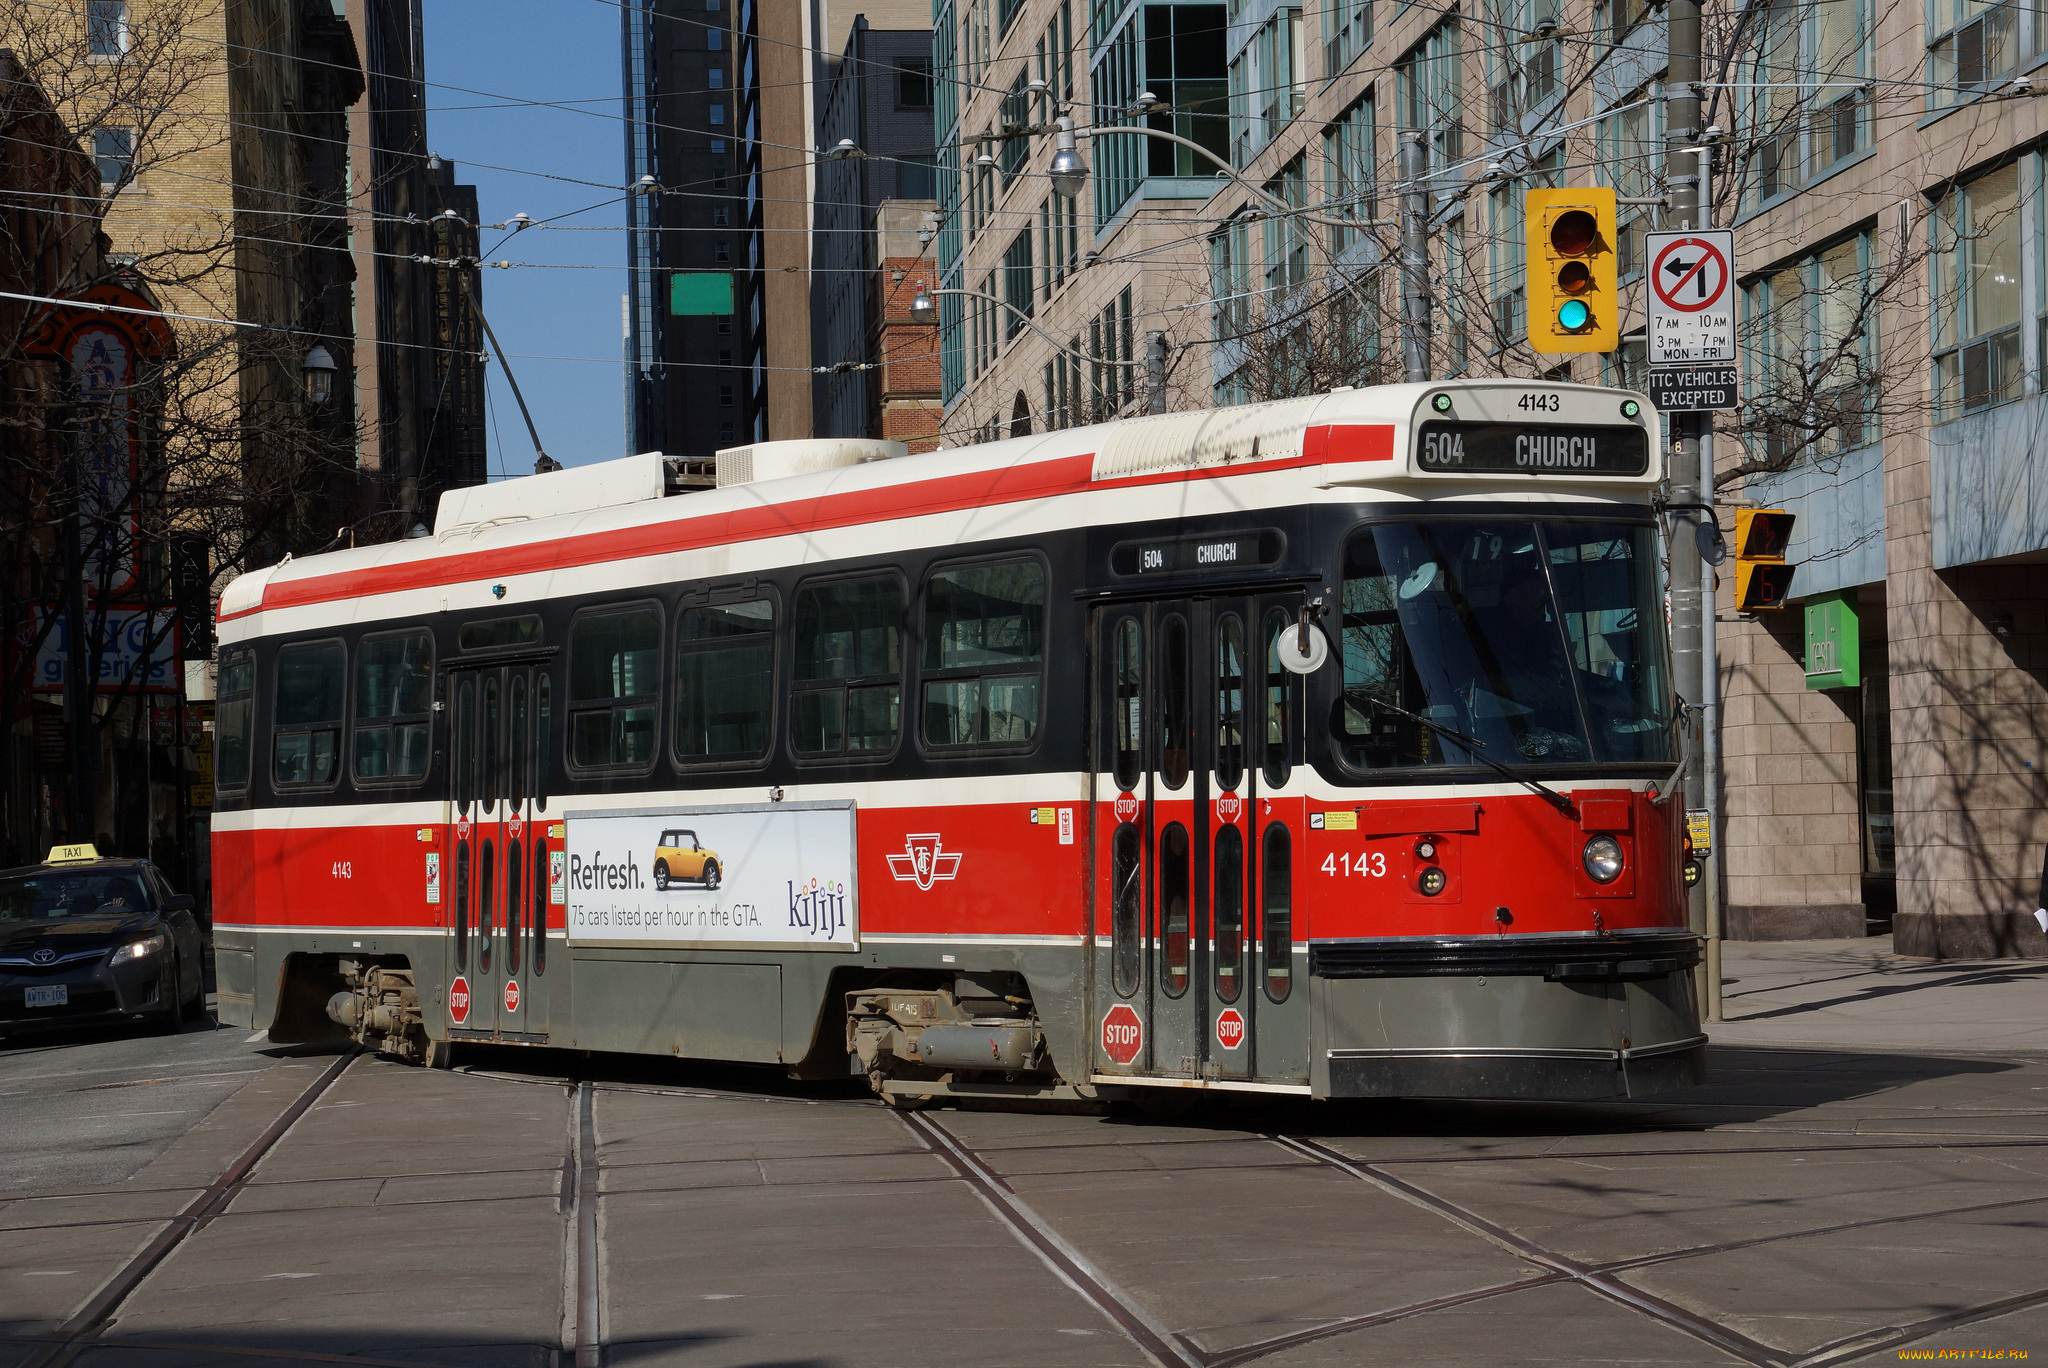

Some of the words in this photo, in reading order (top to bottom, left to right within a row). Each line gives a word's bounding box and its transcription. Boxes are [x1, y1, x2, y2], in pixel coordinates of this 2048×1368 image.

[1655, 316, 1662, 329] 7
[1666, 319, 1679, 328] AM
[1699, 314, 1711, 328] 10
[1714, 317, 1726, 327] AM
[1657, 336, 1664, 348] 3
[1668, 338, 1681, 348] PM
[1702, 334, 1708, 346] 7
[1713, 336, 1726, 346] PM
[1664, 348, 1689, 360] MON
[1703, 348, 1720, 358] FRI
[1650, 374, 1672, 388] TTC
[1676, 371, 1736, 386] VEHICLES
[1518, 394, 1560, 412] 4143
[1662, 390, 1726, 406] EXCEPTED
[1425, 432, 1465, 464] 504
[1516, 435, 1596, 468] CHURCH
[1144, 550, 1163, 568] 504
[1198, 543, 1237, 564] CHURCH
[1761, 566, 1774, 602] 6
[1117, 800, 1136, 814] STOP
[1220, 799, 1238, 813] STOP
[63, 847, 82, 858] TAXI
[332, 861, 352, 878] 4143
[571, 850, 645, 890] Refresh.
[1320, 852, 1386, 877] 4143
[787, 877, 846, 940] kijiji
[572, 905, 584, 926] 75
[588, 910, 609, 926] cars
[612, 904, 641, 926] listed
[644, 910, 664, 932] per
[666, 904, 694, 926] hour
[698, 905, 707, 926] in
[710, 903, 729, 926] the
[732, 904, 762, 926] GTA.
[452, 992, 468, 1008] STOP
[506, 990, 518, 1002] STOP
[1106, 1024, 1138, 1044] STOP
[1220, 1021, 1241, 1037] STOP
